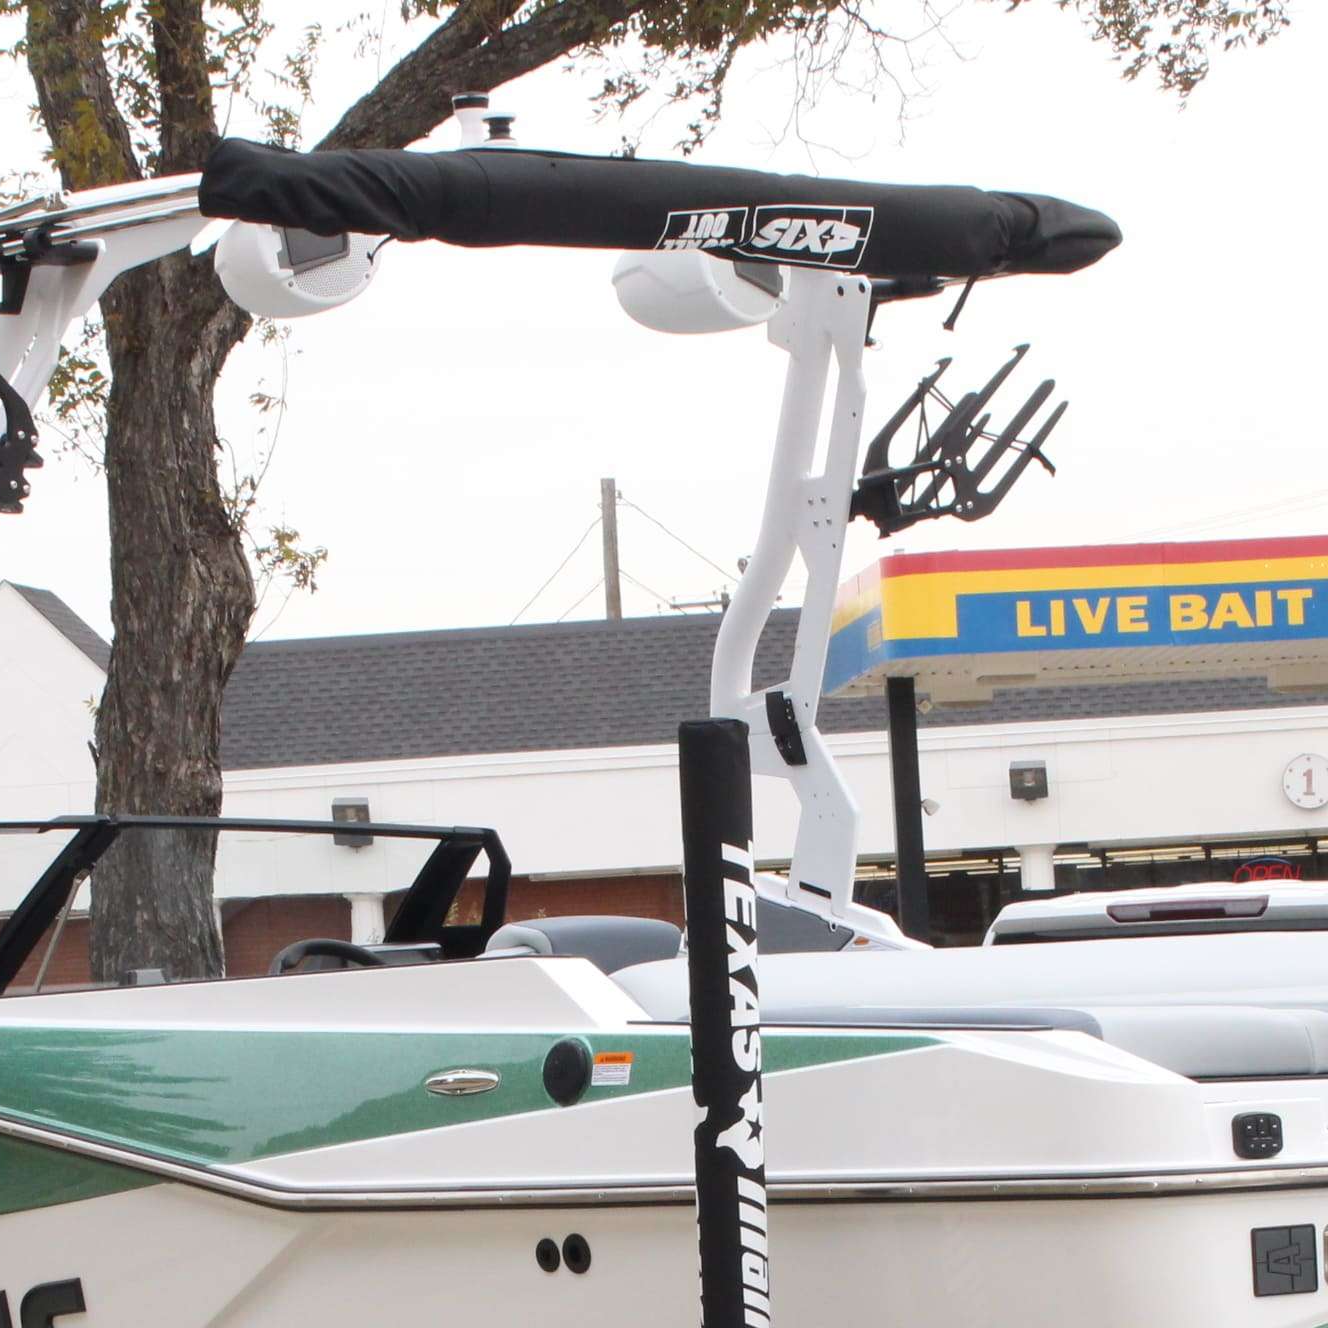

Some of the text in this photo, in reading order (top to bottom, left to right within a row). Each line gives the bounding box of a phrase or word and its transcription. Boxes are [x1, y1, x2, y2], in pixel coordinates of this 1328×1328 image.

[1016, 595, 1149, 638] LIVE
[1169, 588, 1313, 632] BAIT
[1302, 767, 1316, 796] 1
[721, 839, 761, 1073] TEXAS
